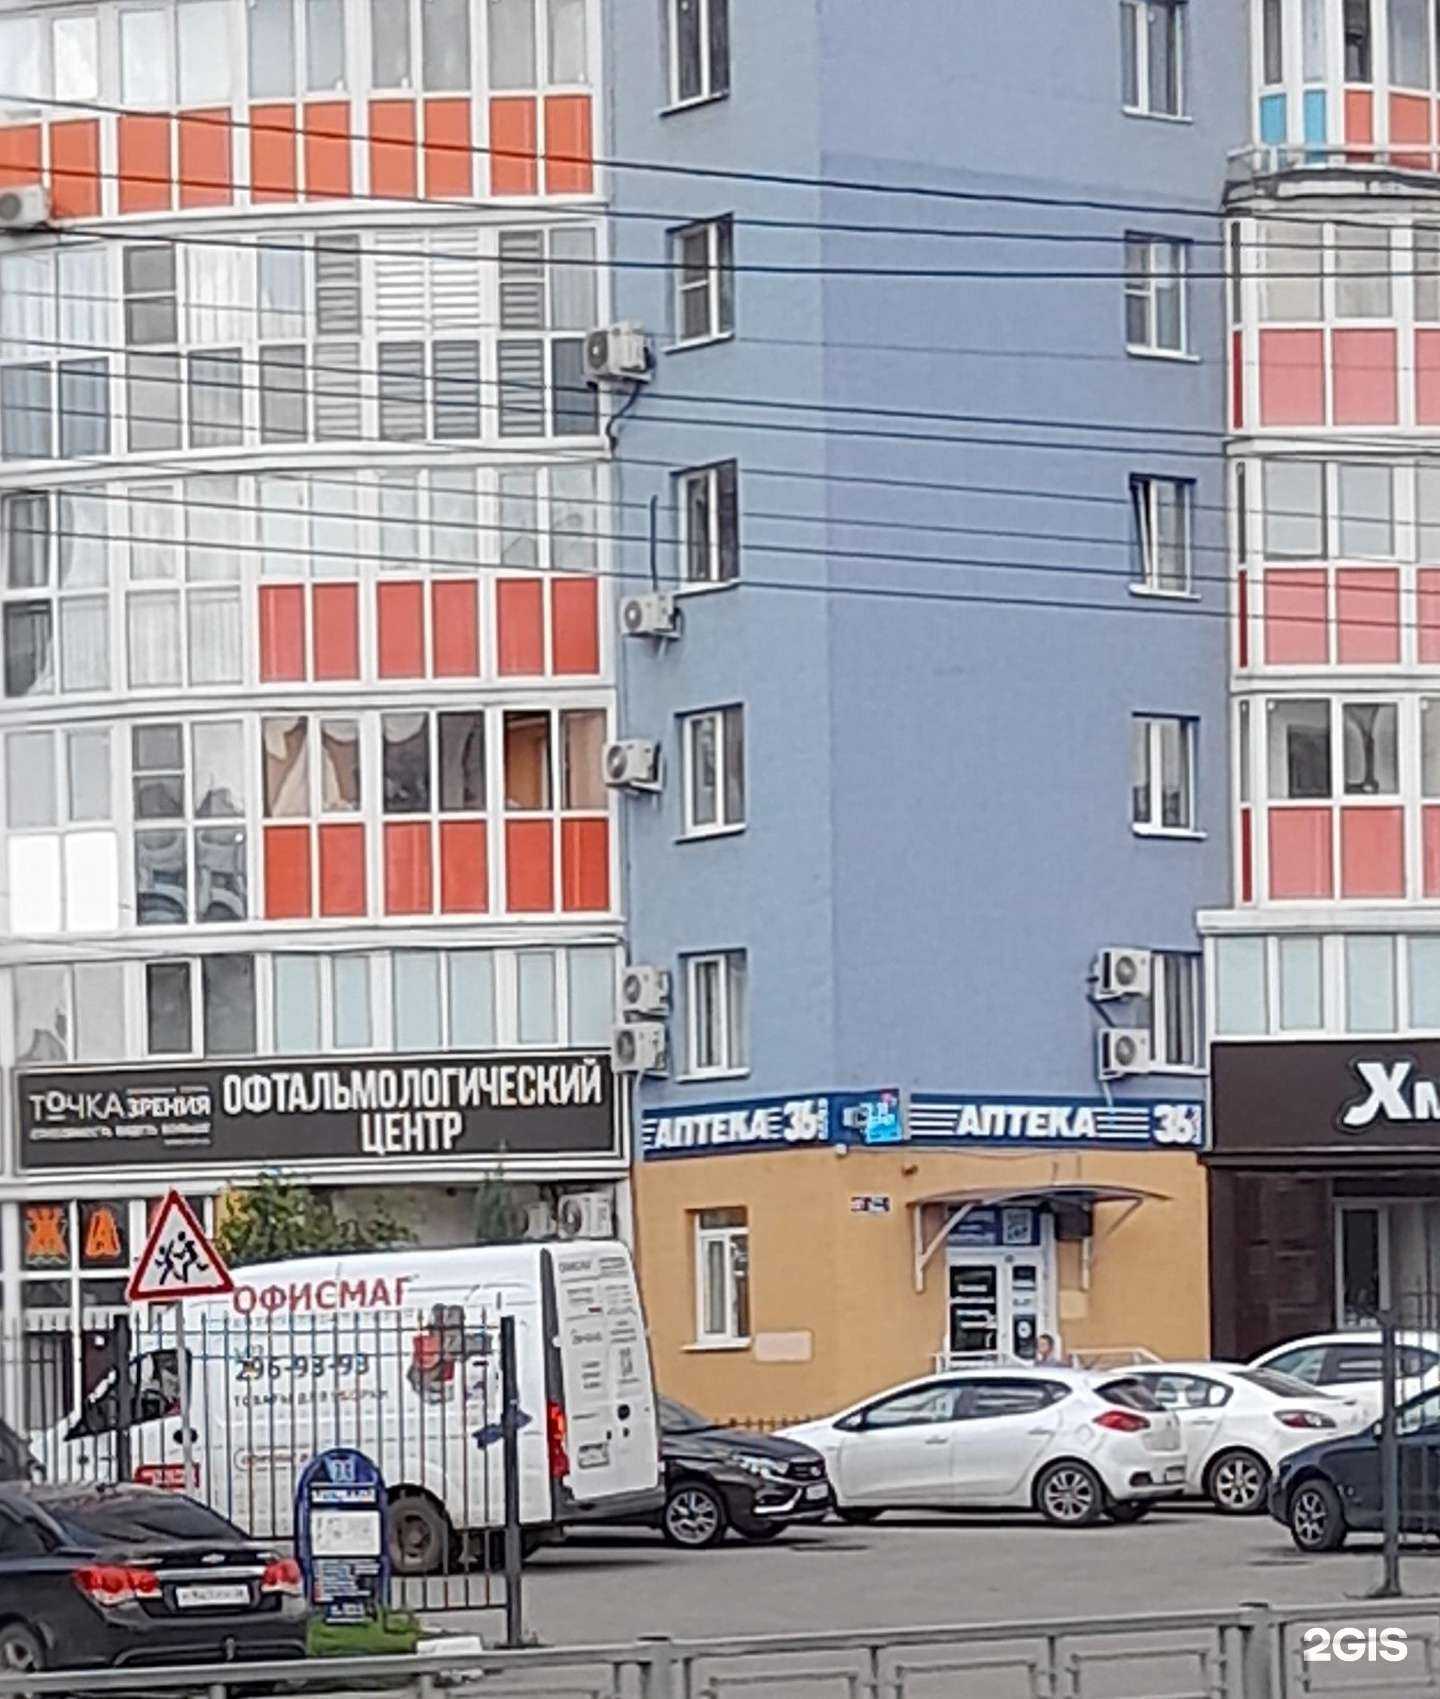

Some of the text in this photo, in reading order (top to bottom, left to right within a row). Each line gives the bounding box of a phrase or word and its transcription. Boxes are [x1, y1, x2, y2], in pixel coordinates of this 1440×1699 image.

[223, 1057, 602, 1115] ОФТАЛЬМОЛОГИЧЕСКИЙ
[29, 1091, 211, 1122] ТОЧКА ЗРЕНИЯ
[956, 1104, 1097, 1138] АПТЕКА
[360, 1111, 463, 1154] ЦЕНТР
[654, 1108, 769, 1149] АПТЕКА
[233, 1276, 410, 1315] ОФИСМАГ
